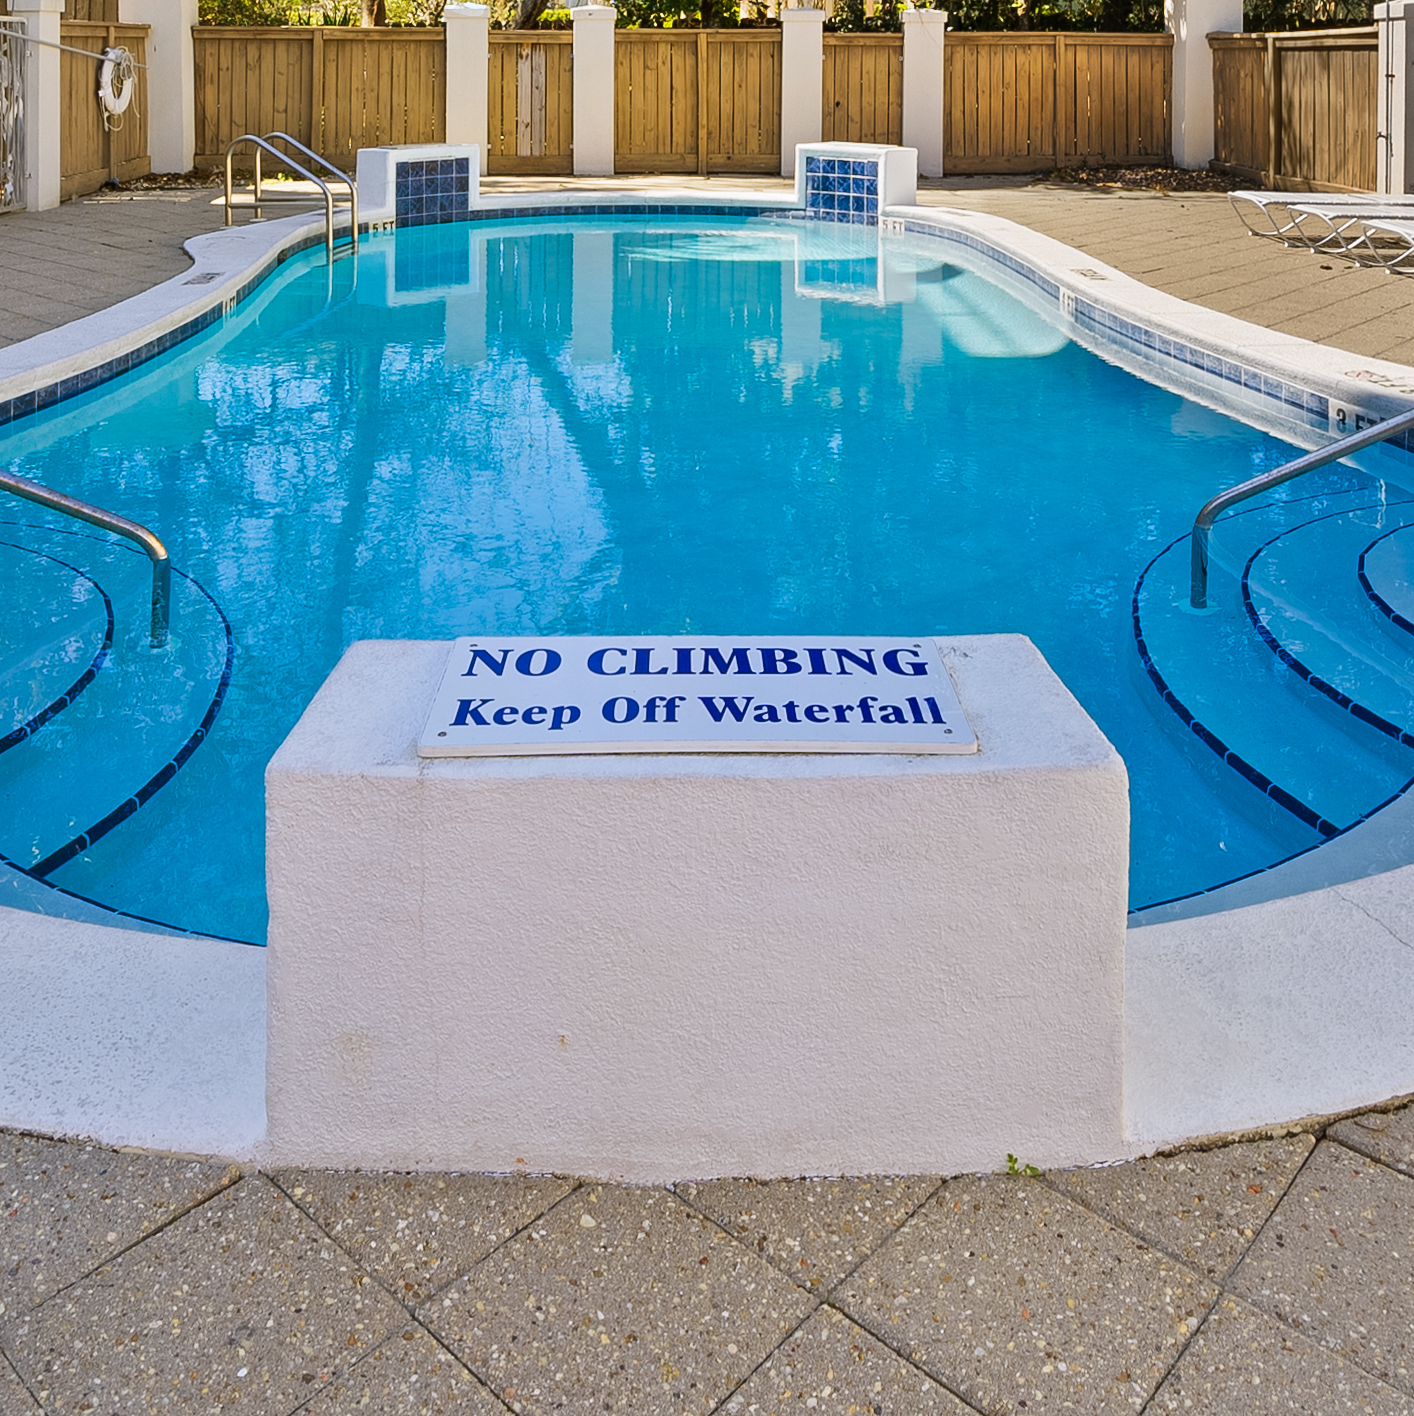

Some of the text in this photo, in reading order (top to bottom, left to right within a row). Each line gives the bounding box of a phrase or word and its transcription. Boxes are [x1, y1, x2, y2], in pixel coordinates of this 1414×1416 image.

[383, 220, 395, 232] FT
[460, 647, 929, 677] NO CLIMBING
[448, 696, 947, 731] Keep Off Waterfall
